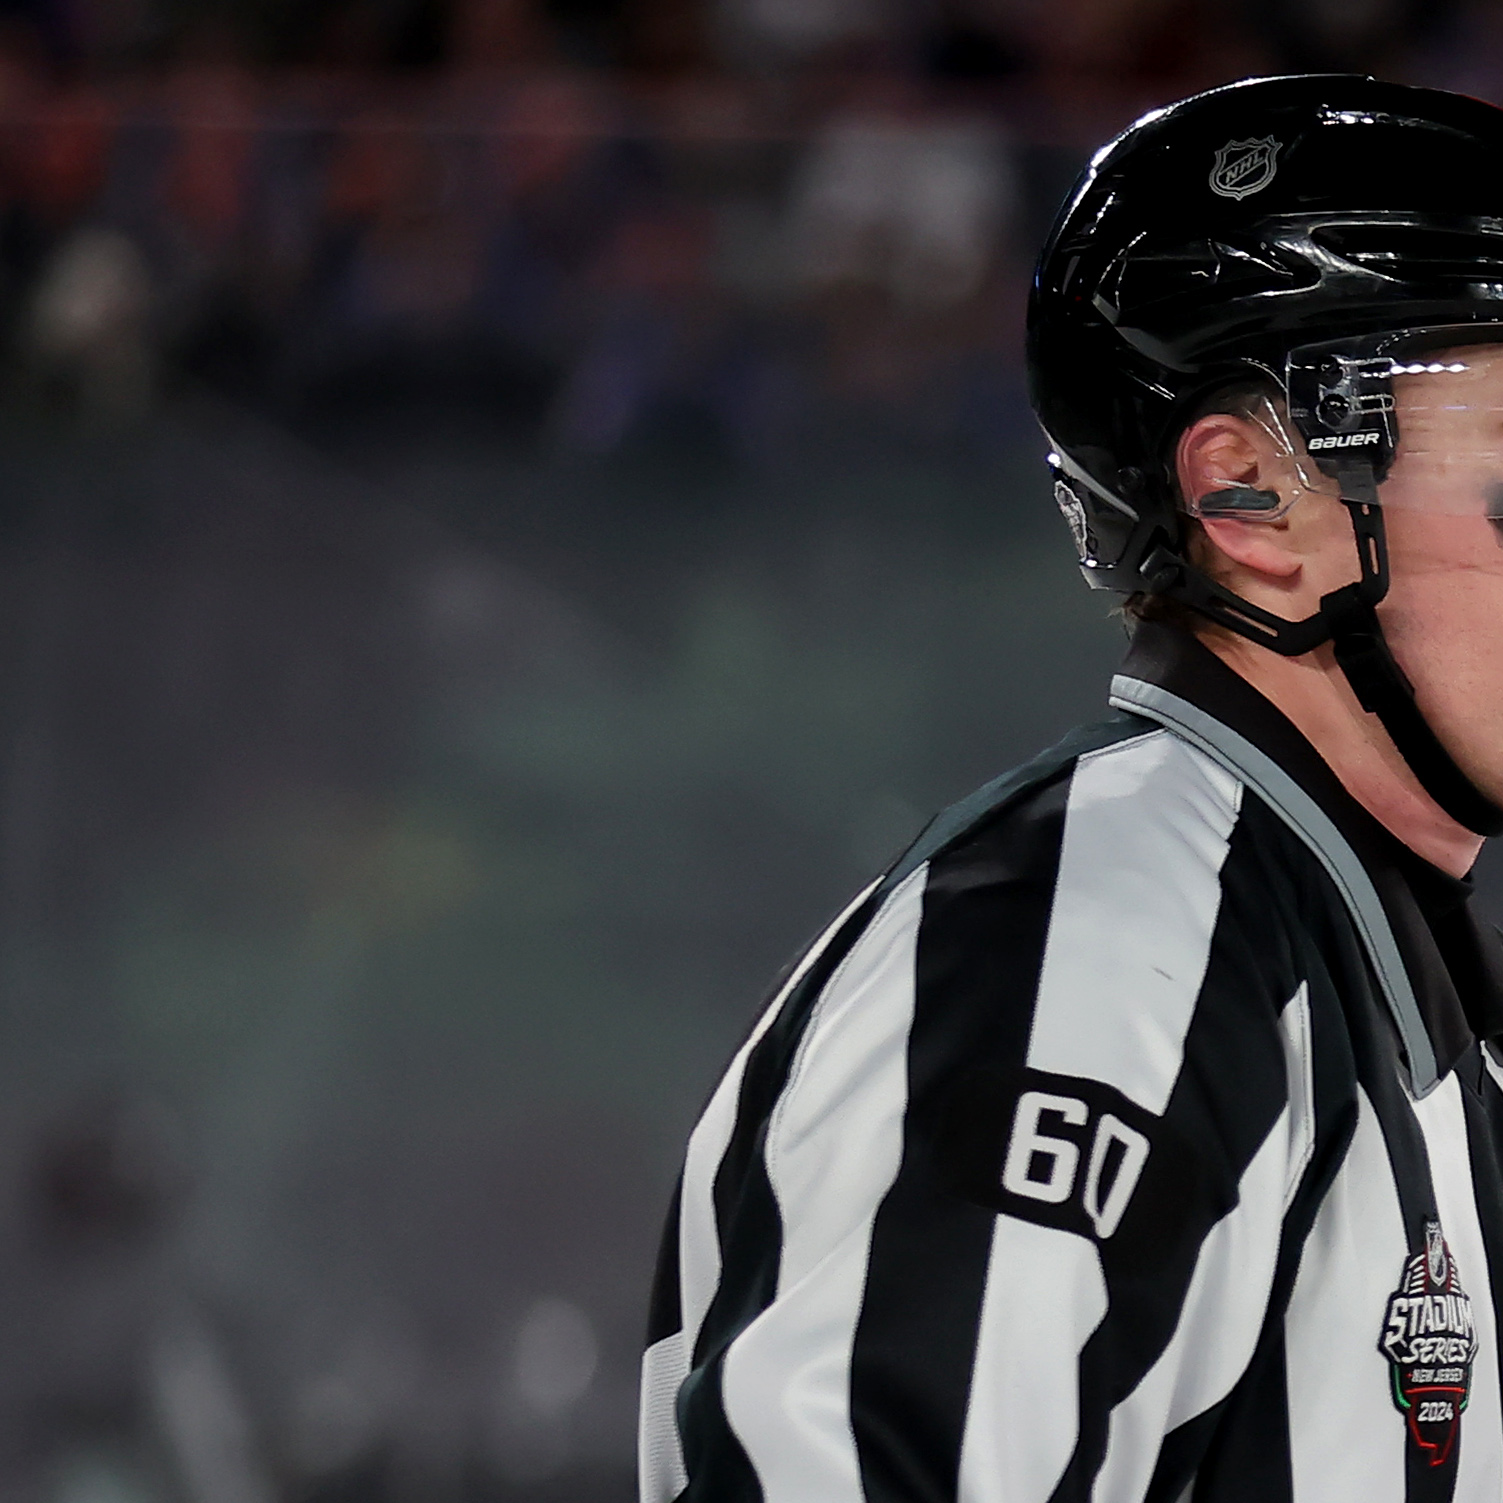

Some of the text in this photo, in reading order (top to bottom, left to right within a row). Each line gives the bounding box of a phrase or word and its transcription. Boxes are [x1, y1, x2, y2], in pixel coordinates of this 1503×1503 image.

[1226, 151, 1264, 184] NHL
[1308, 432, 1380, 450] BAUER
[1002, 1091, 1151, 1239] 60
[1385, 1295, 1476, 1344] STADIUM
[1402, 1336, 1471, 1364] SERIES
[1417, 1401, 1454, 1422] 2024
